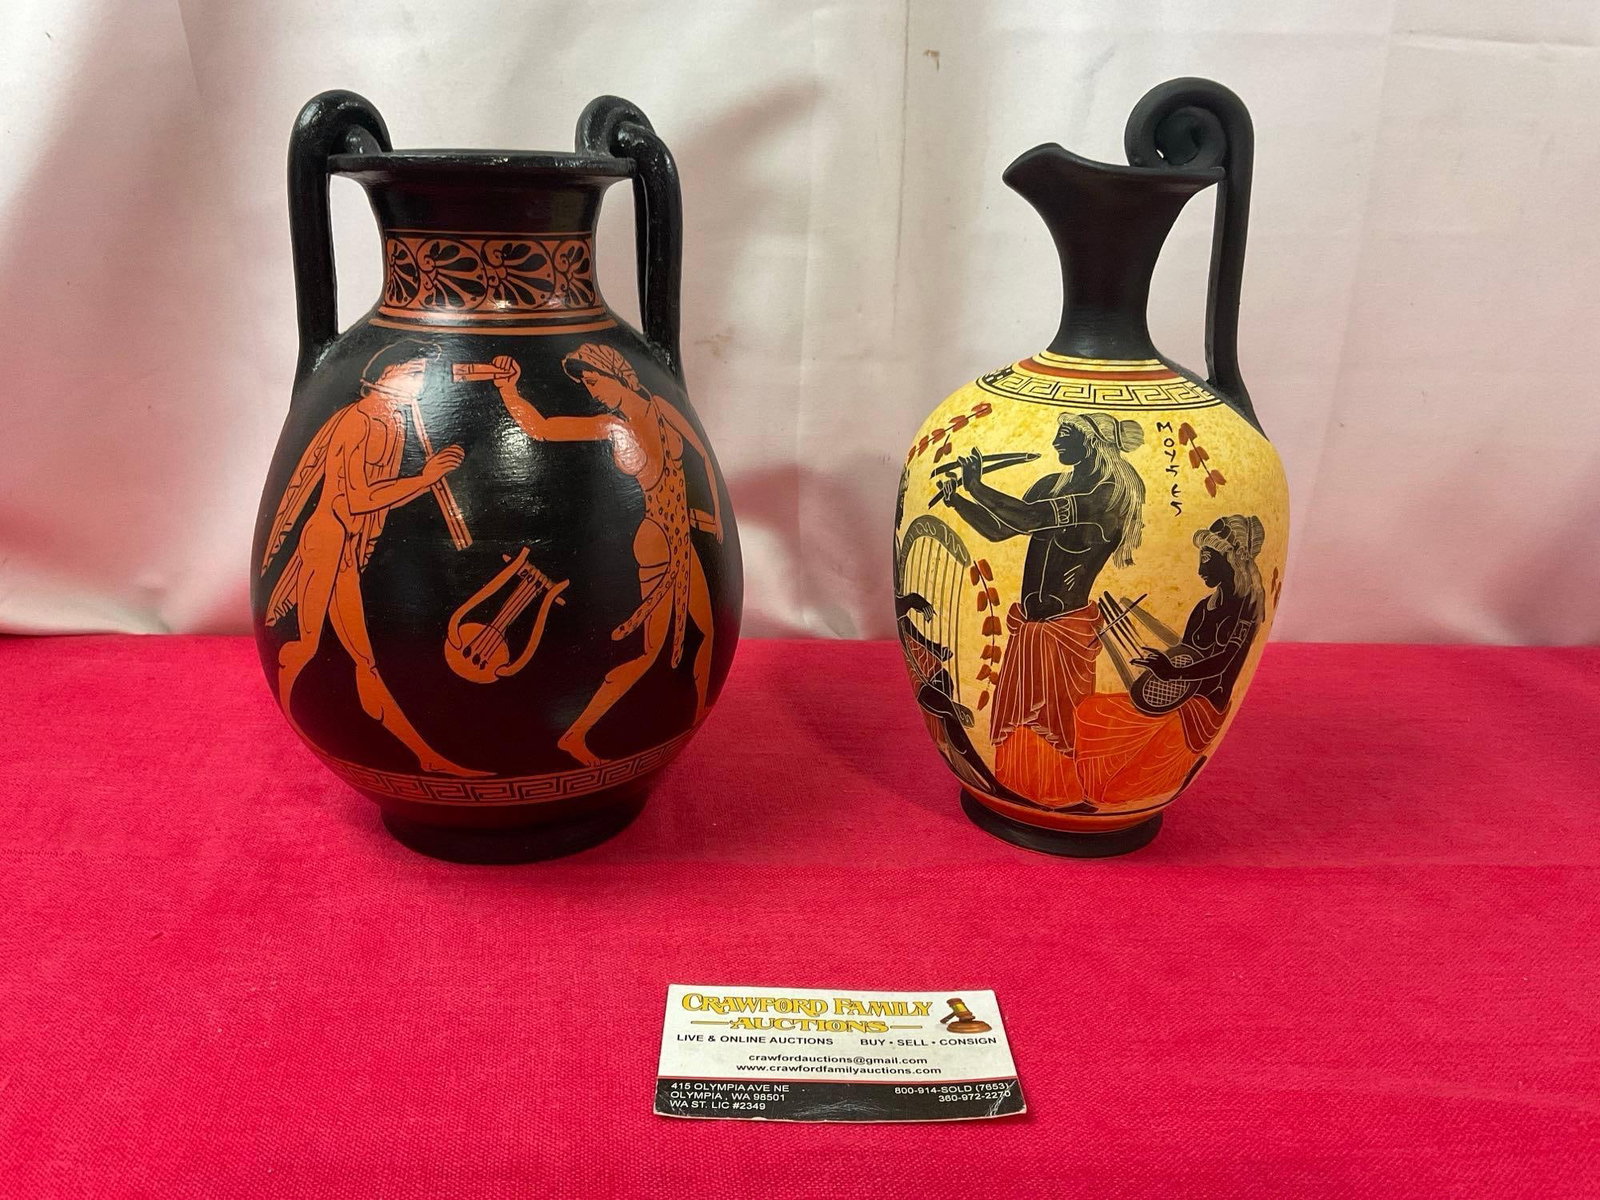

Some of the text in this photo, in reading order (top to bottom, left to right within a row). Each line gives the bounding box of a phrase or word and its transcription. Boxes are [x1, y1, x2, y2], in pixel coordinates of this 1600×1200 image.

[681, 993, 933, 1017] CRAWFORD FAMILY
[729, 1017, 889, 1033] AUCTIONS
[677, 1034, 703, 1042] LIVE
[720, 1035, 766, 1043] ONLINE
[769, 1036, 834, 1045] AUCTIONS
[939, 1037, 997, 1046] CONSIGN
[748, 1054, 928, 1066] crawfordauctions@gmail.com
[736, 1064, 942, 1075] www.crawfordfamilyauctions.com
[694, 1083, 746, 1091] OLYMPIA
[746, 1084, 770, 1092] AVE
[773, 1084, 790, 1092] NE
[894, 1082, 1009, 1095] 800-914-SOLD (7653)
[753, 1093, 785, 1101] 98501
[938, 1090, 1011, 1103] 360-972-2270
[691, 1100, 708, 1108] ST.
[711, 1101, 730, 1109] LIC
[732, 1102, 766, 1110] #2349
